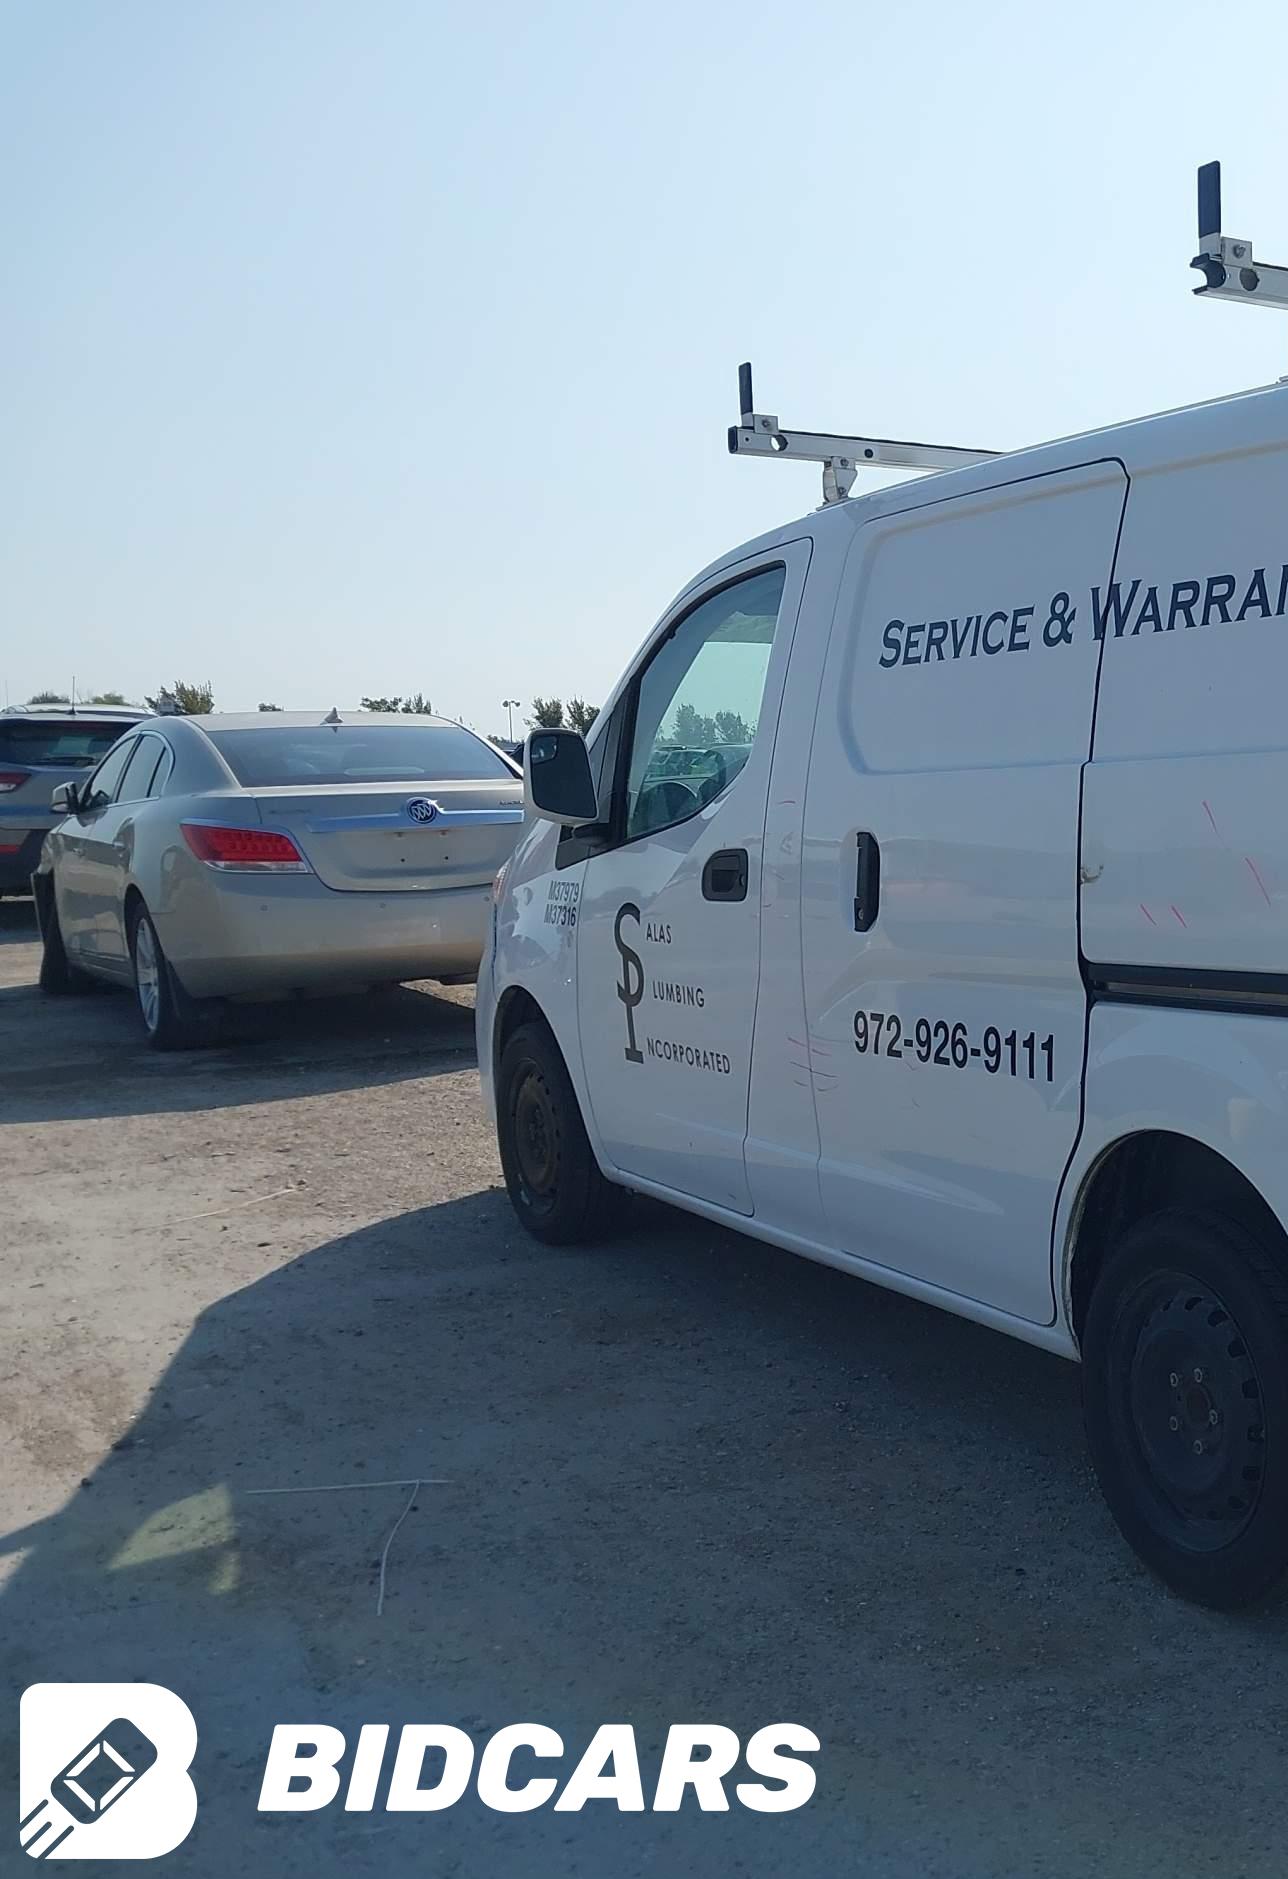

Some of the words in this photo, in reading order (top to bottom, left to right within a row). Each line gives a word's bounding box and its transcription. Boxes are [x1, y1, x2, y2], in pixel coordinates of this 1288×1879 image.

[878, 604, 1035, 668] SERVICE
[1043, 591, 1077, 648] &
[853, 1010, 1055, 1082] 972-926-9111
